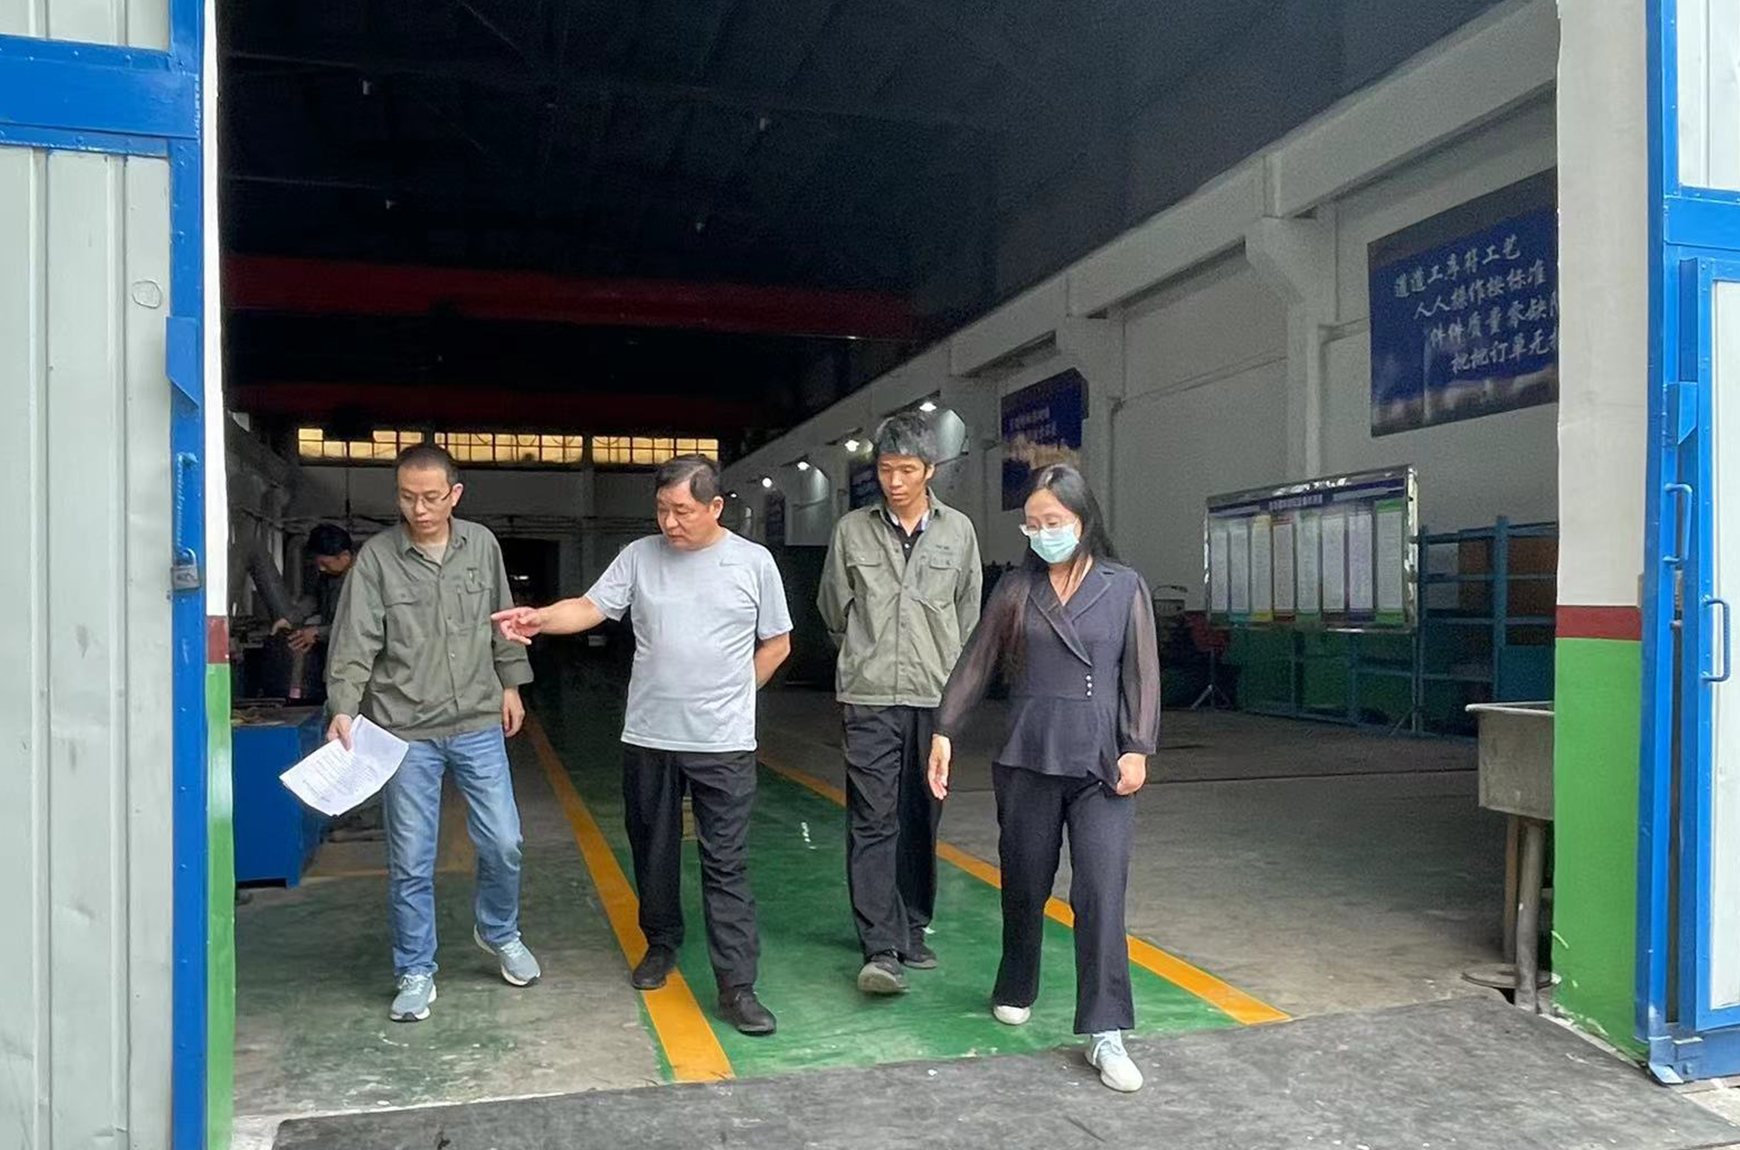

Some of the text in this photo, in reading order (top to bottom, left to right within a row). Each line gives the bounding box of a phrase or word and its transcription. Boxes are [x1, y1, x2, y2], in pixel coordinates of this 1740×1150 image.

[1413, 260, 1546, 319] 人人操作按标准
